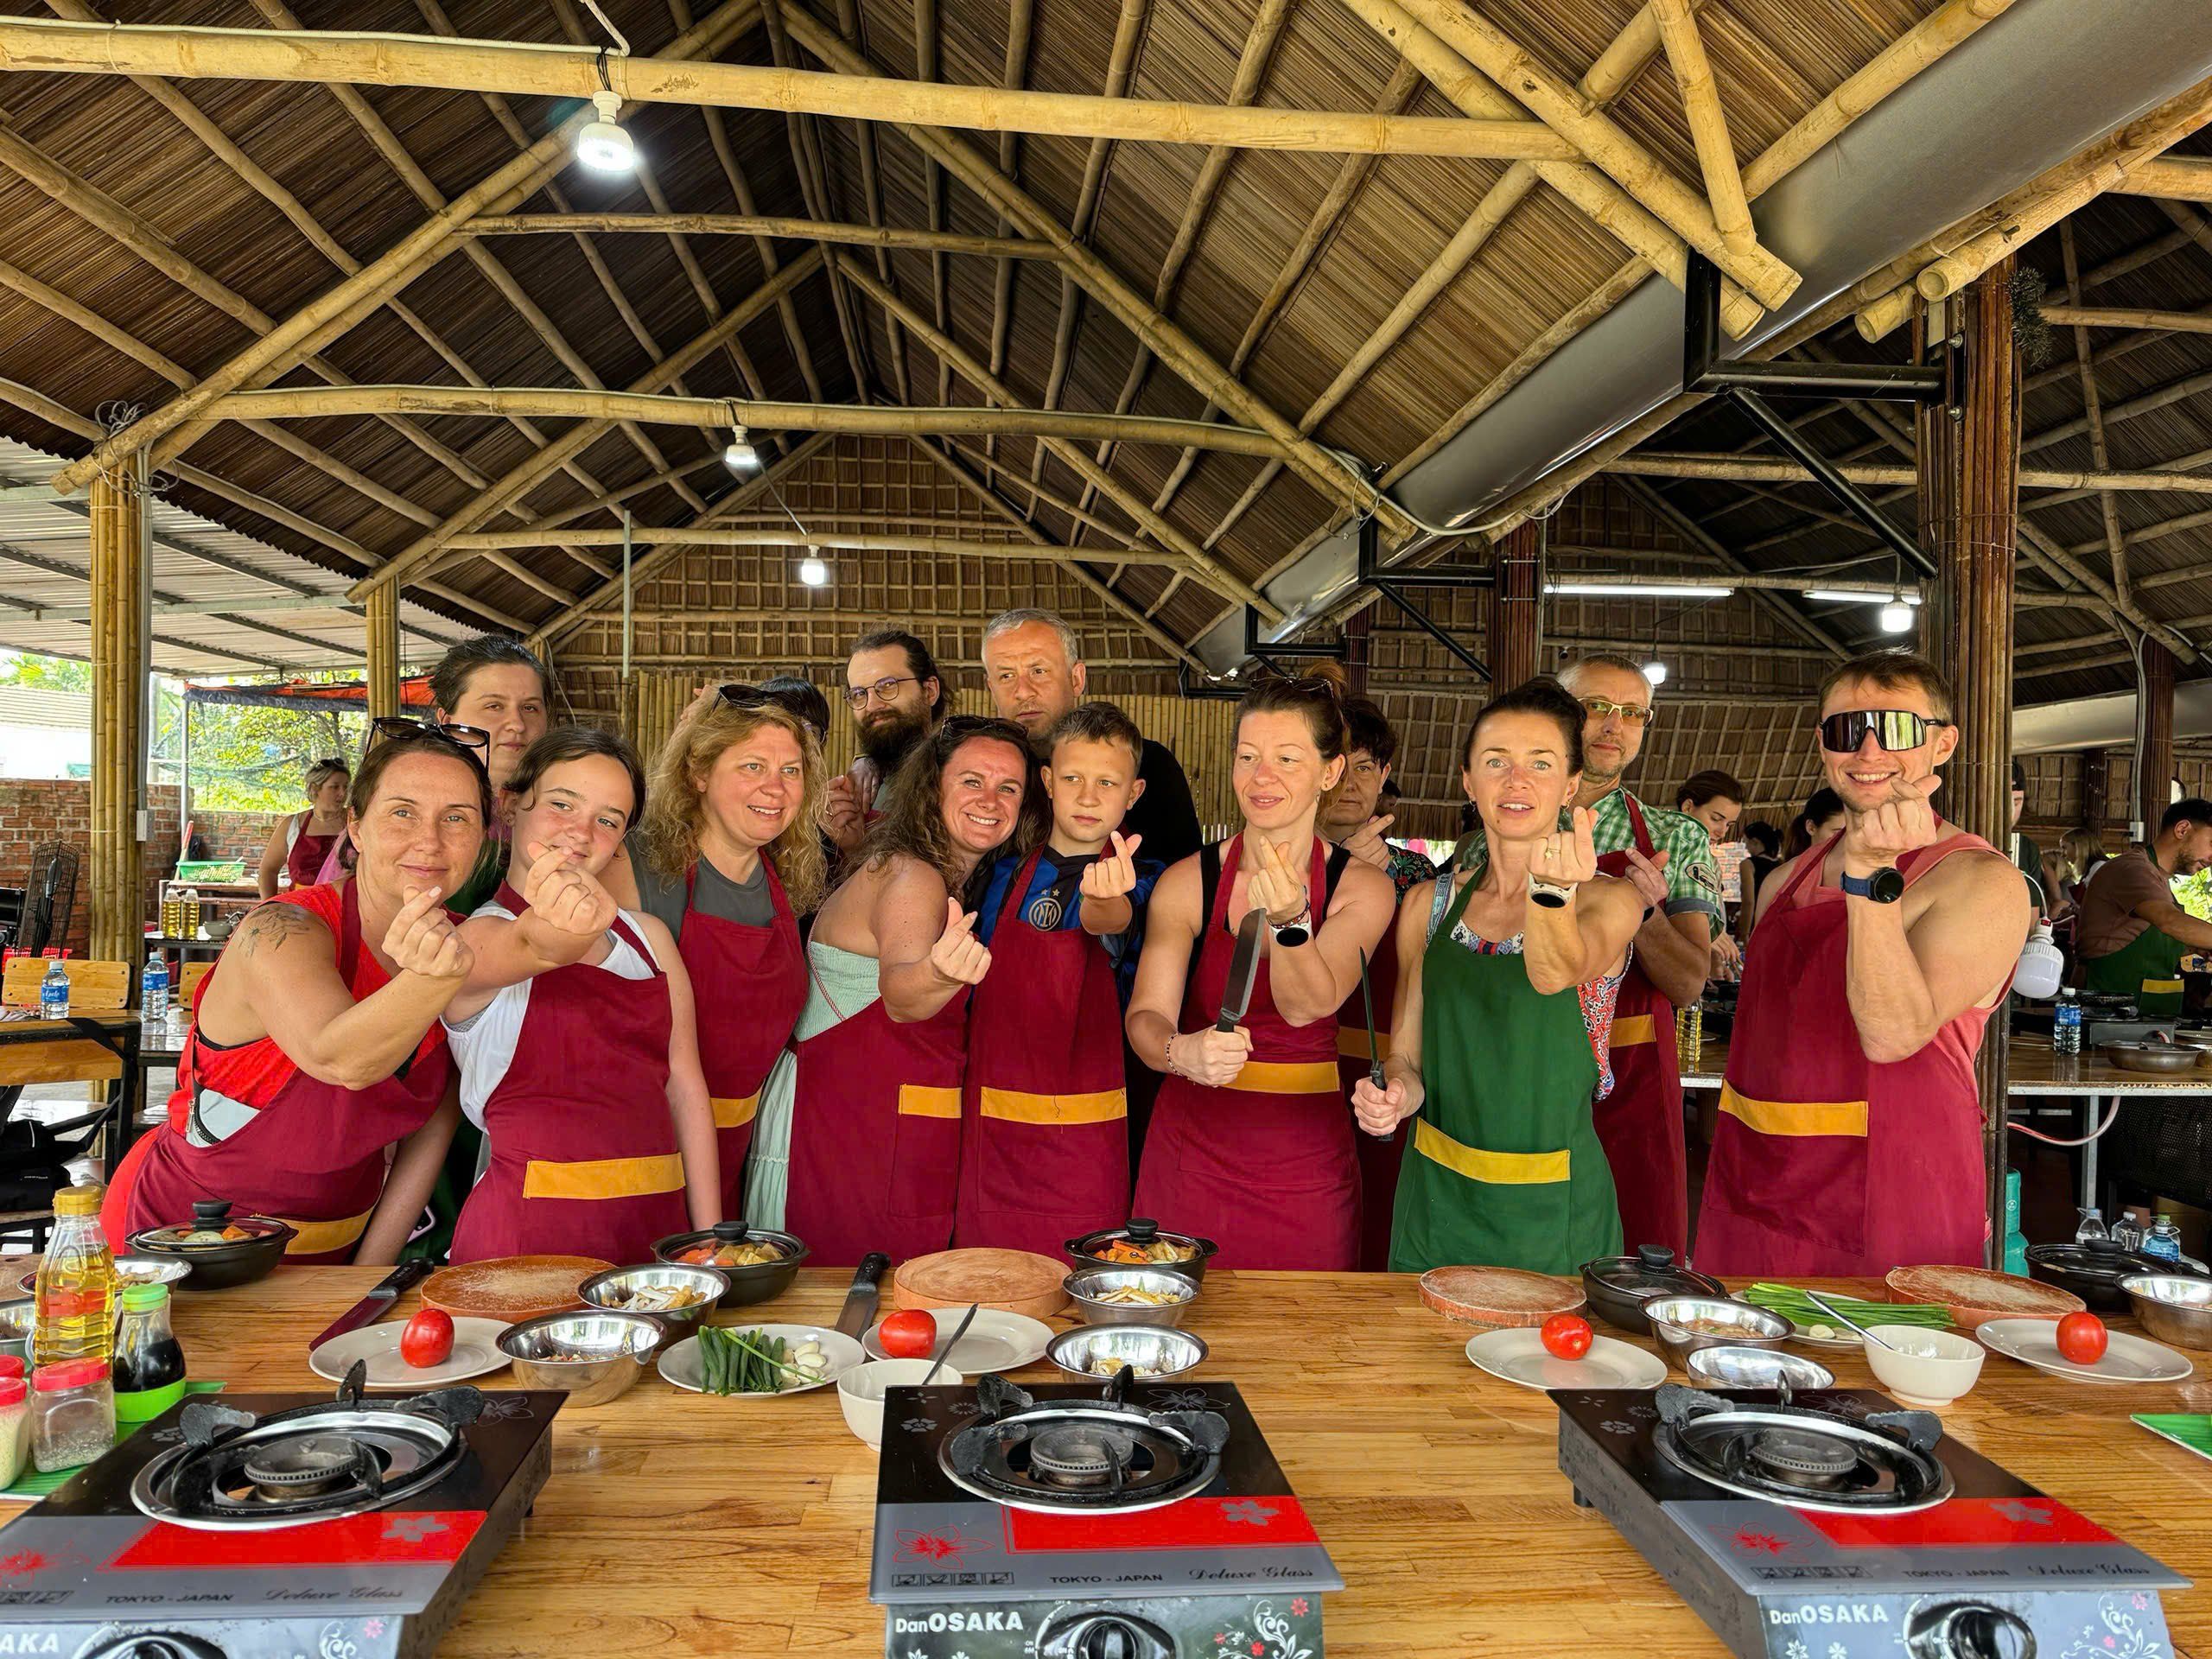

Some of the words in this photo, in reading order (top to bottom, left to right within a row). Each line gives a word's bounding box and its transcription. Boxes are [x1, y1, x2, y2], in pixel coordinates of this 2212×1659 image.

[1049, 1575, 1103, 1584] TOKYO
[1115, 1573, 1164, 1583] JAPAN
[1188, 1567, 1256, 1580] Deluxe
[1262, 1566, 1313, 1578] Glass
[105, 1594, 165, 1604] TOKYO
[175, 1593, 236, 1603] JAPAN
[1769, 1604, 1890, 1624] DanOSAKA
[894, 1611, 1024, 1633] DanOSAKA
